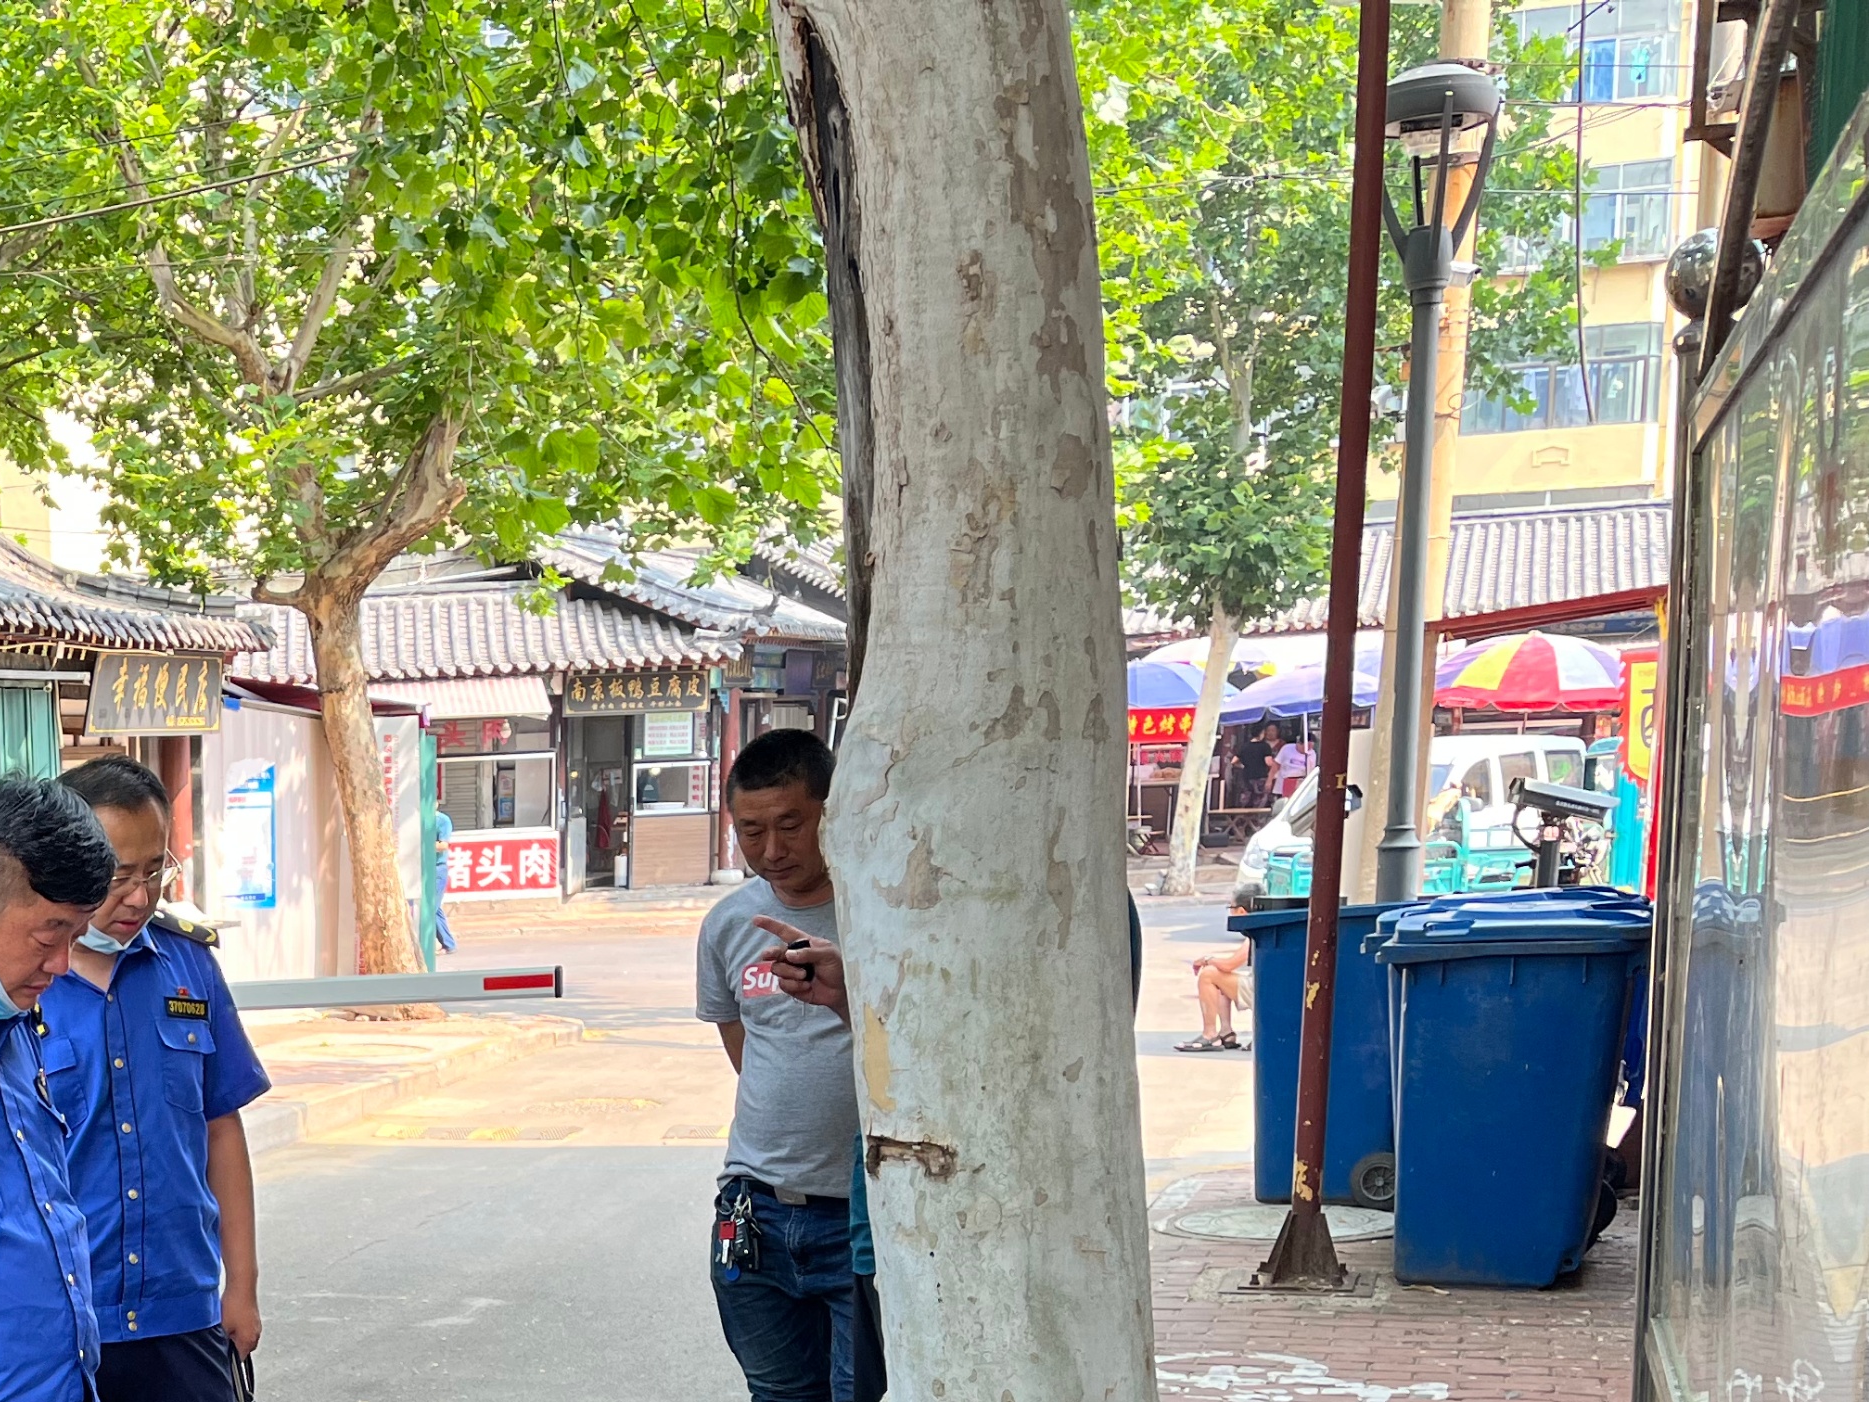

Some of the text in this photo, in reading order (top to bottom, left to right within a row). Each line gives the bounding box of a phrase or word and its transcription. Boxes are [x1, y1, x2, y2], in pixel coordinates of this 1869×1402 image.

[571, 675, 702, 702] 南京板鸭豆腐皮
